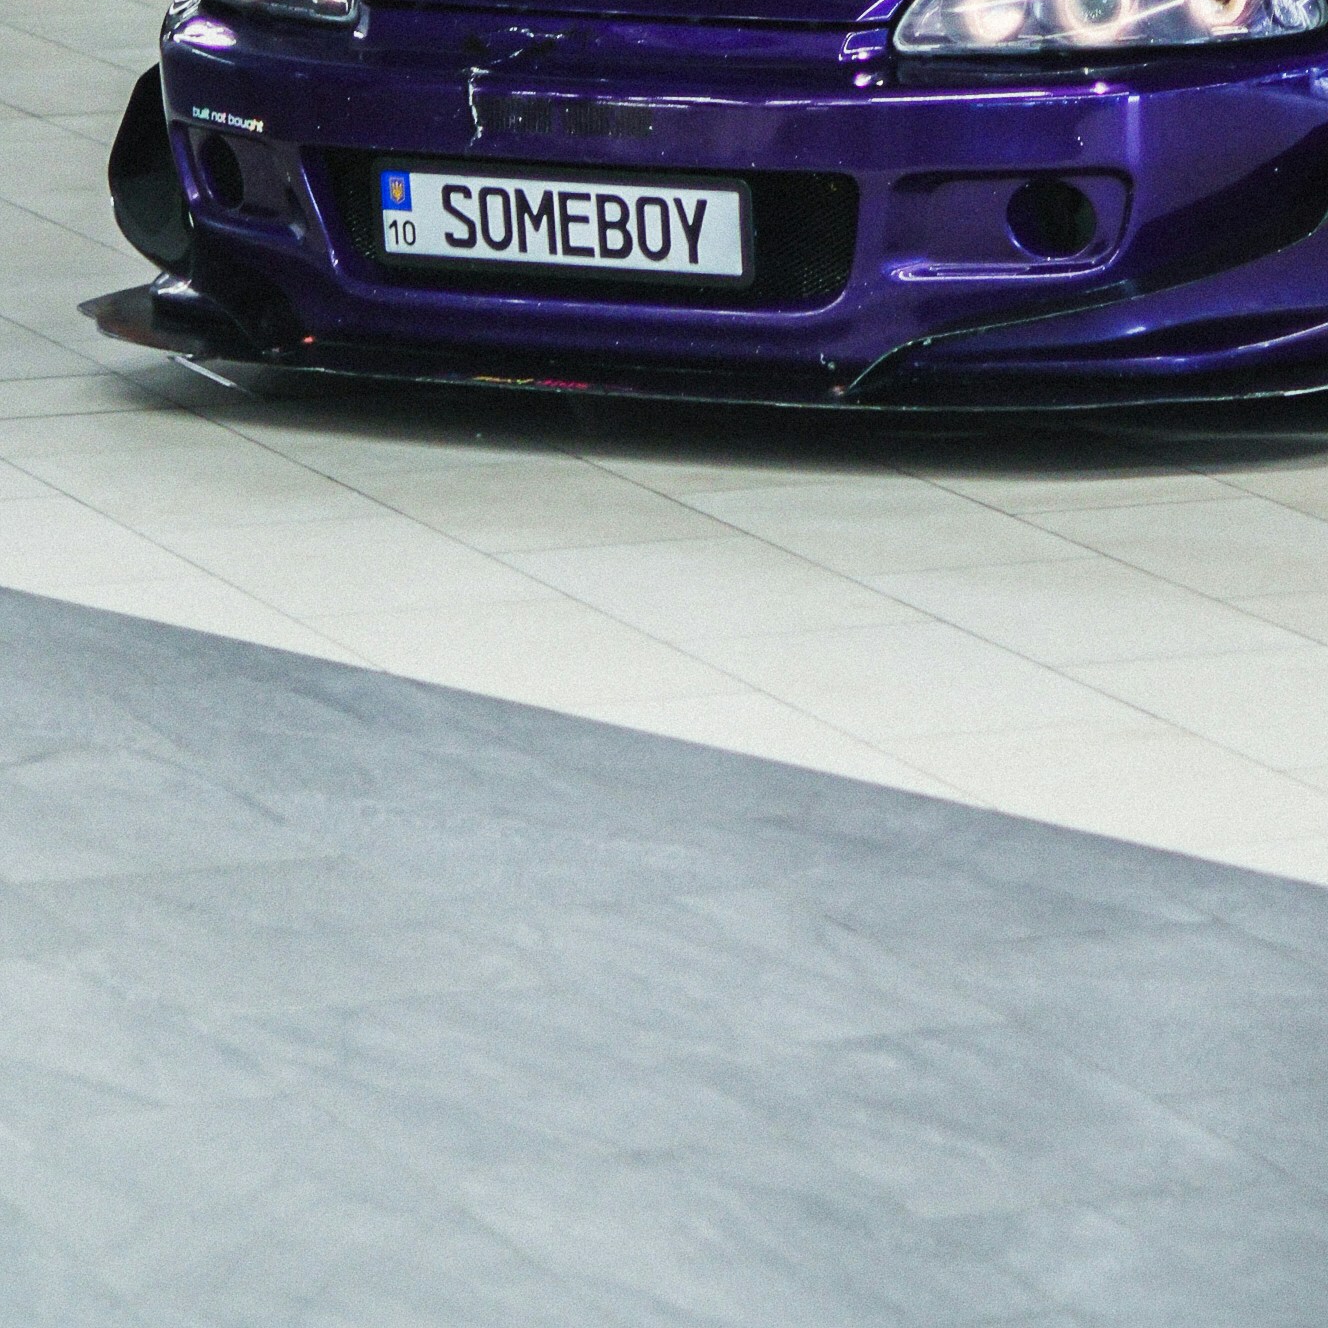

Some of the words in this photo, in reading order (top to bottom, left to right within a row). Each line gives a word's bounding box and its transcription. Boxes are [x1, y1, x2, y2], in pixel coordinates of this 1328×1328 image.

[211, 111, 227, 124] not
[227, 113, 264, 133] bought
[388, 219, 416, 246] 10
[441, 183, 708, 265] SOMEBOY
